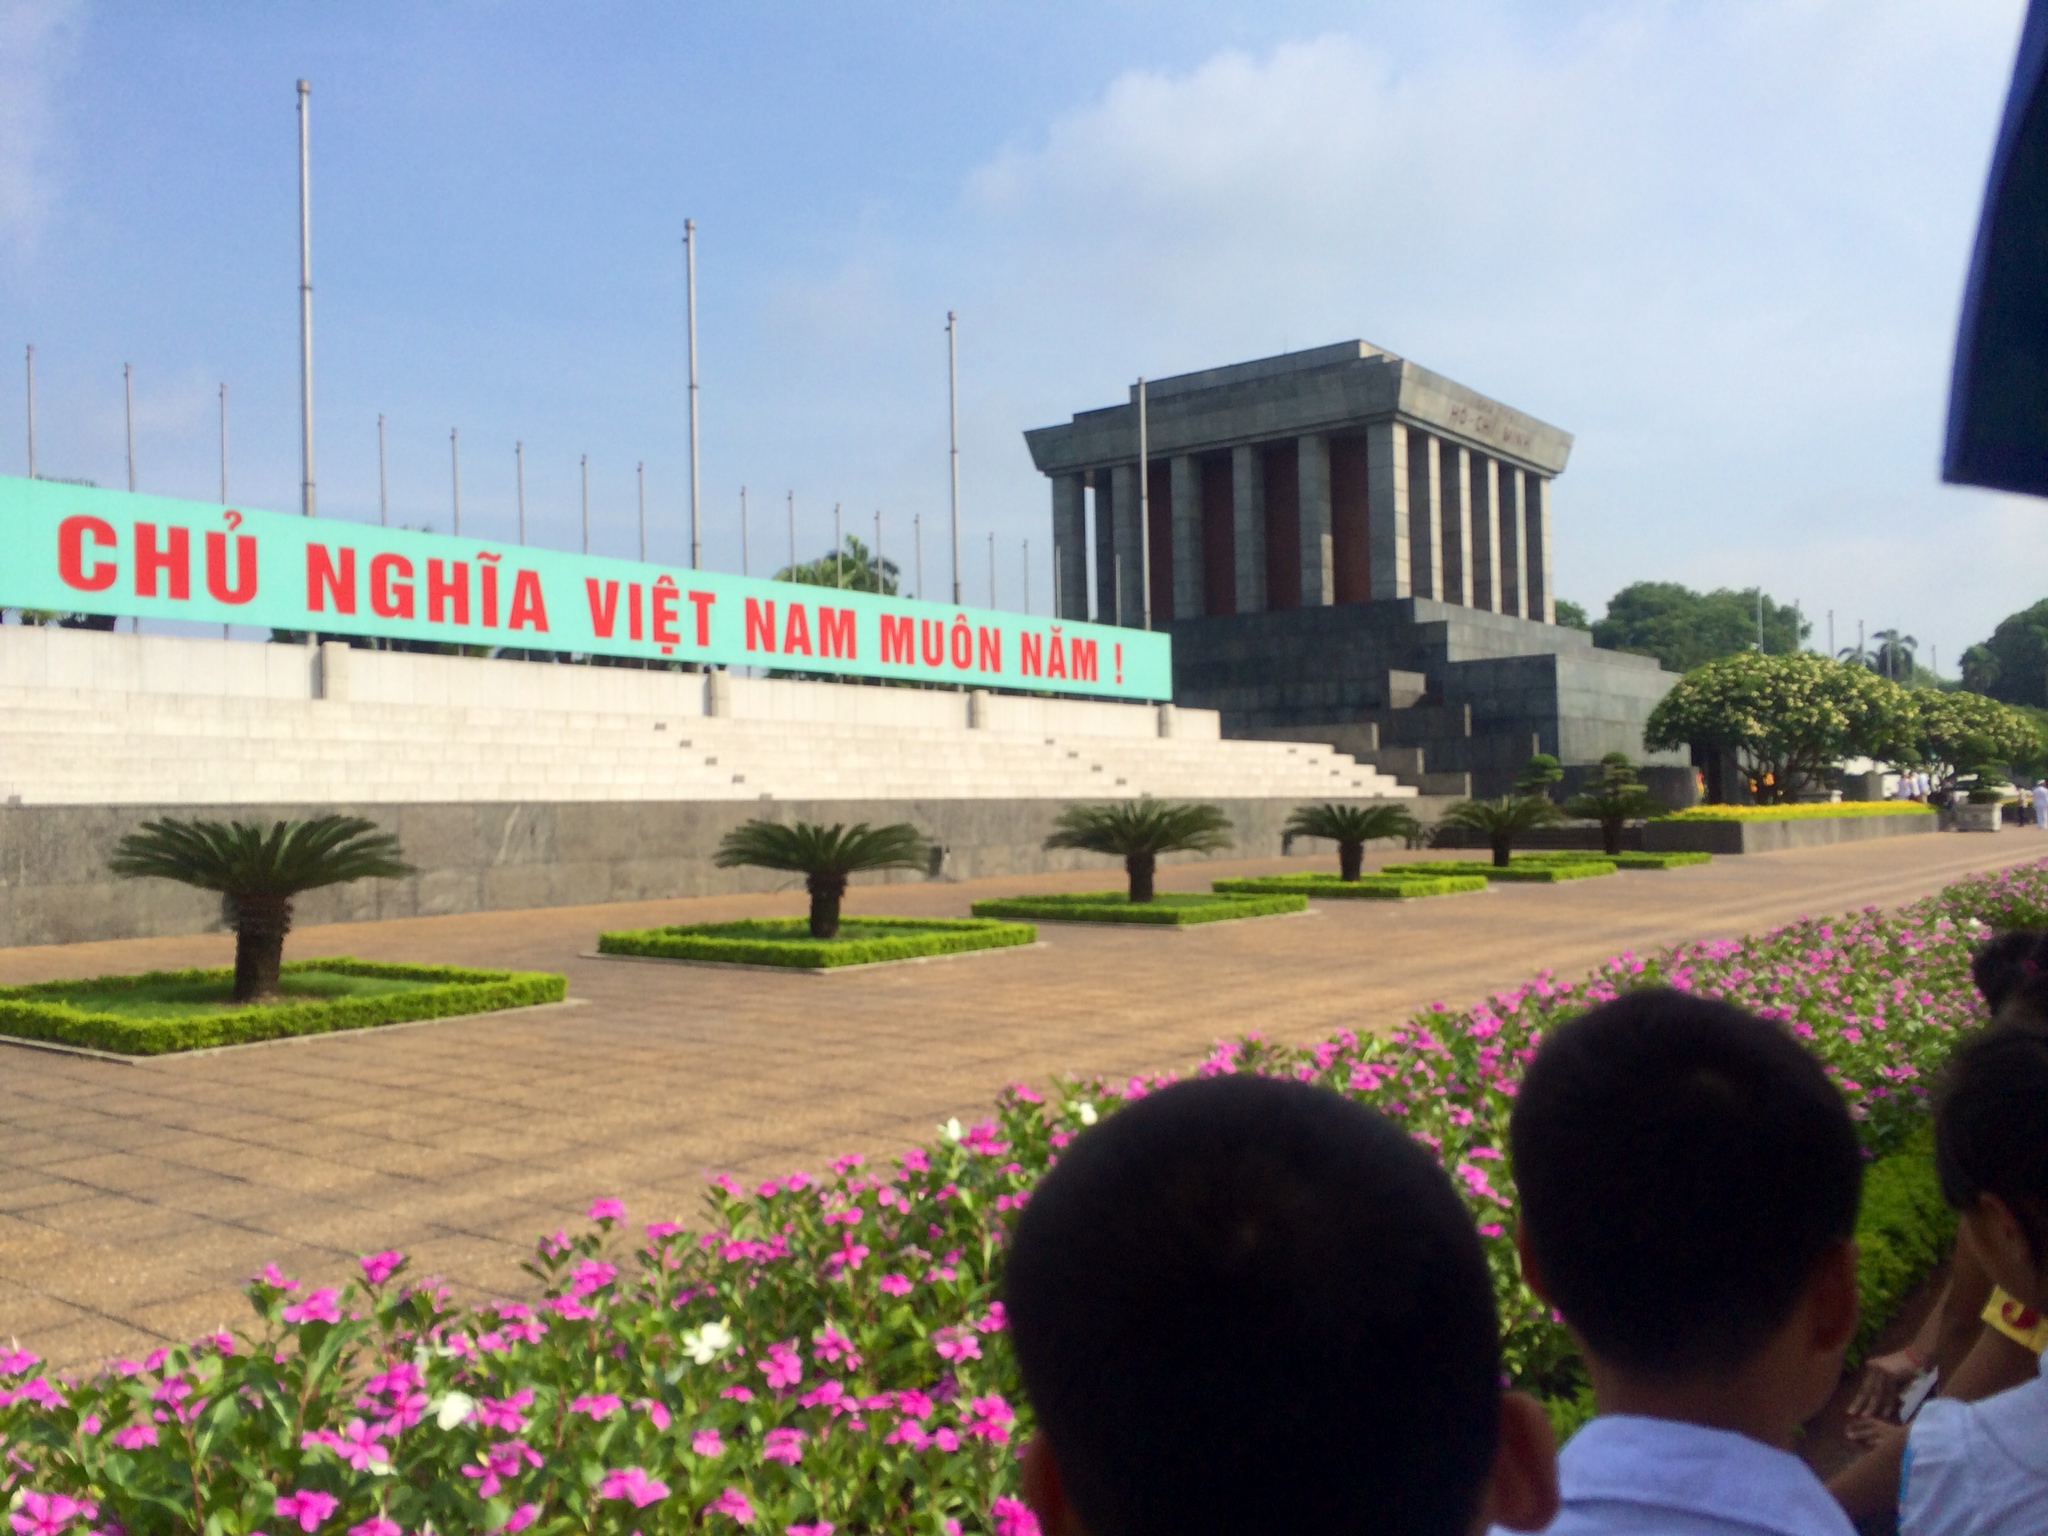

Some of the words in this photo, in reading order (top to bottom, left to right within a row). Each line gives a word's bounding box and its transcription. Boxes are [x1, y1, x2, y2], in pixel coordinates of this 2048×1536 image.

[58, 510, 258, 605] CHỦ
[306, 542, 549, 633] NGHĨA
[584, 574, 716, 655] VIỆT
[744, 597, 857, 660] NAM
[879, 613, 1002, 673] MUÔN
[1020, 627, 1098, 682] NĂM
